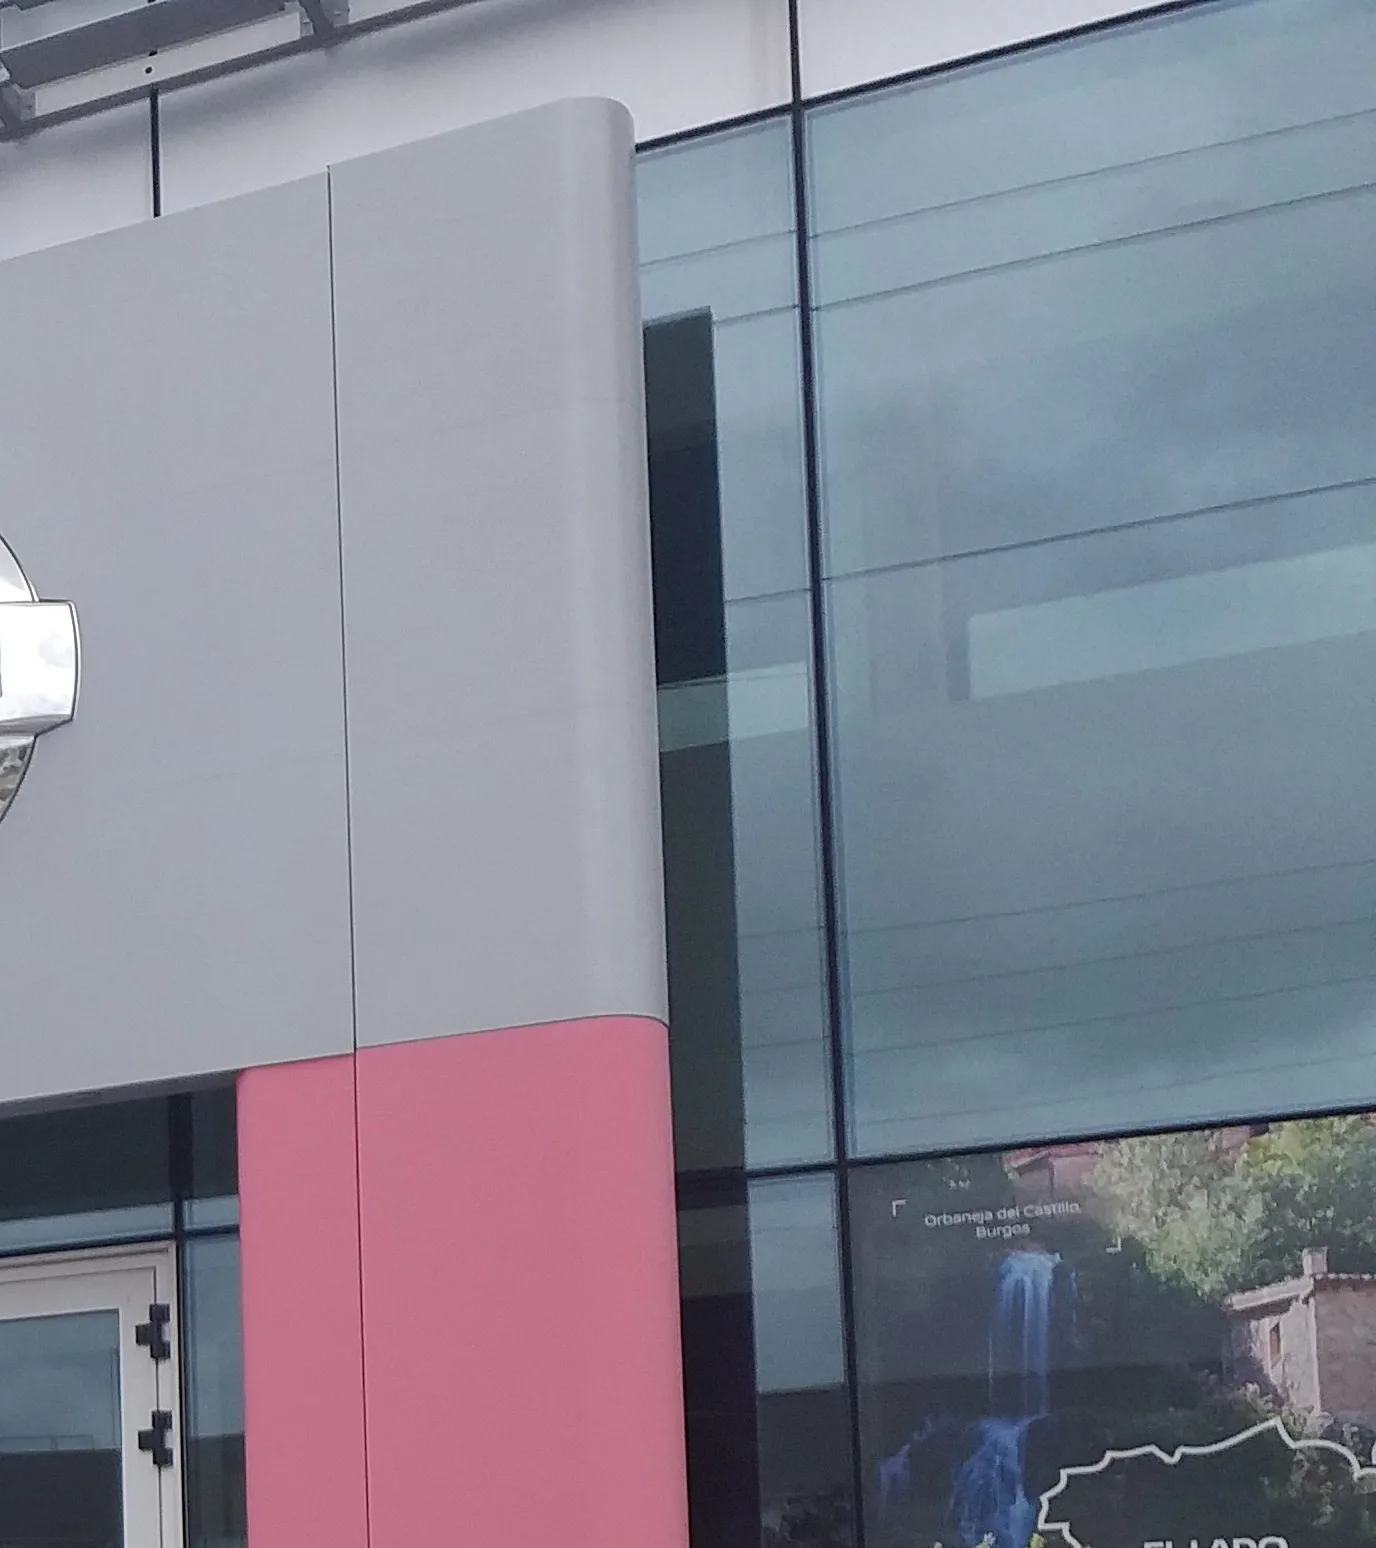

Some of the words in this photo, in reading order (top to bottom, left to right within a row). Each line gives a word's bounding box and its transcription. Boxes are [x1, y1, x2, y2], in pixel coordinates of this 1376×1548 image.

[924, 1209, 993, 1227] Orbaneja
[996, 1205, 1020, 1220] del
[976, 1222, 1031, 1239] Burgos
